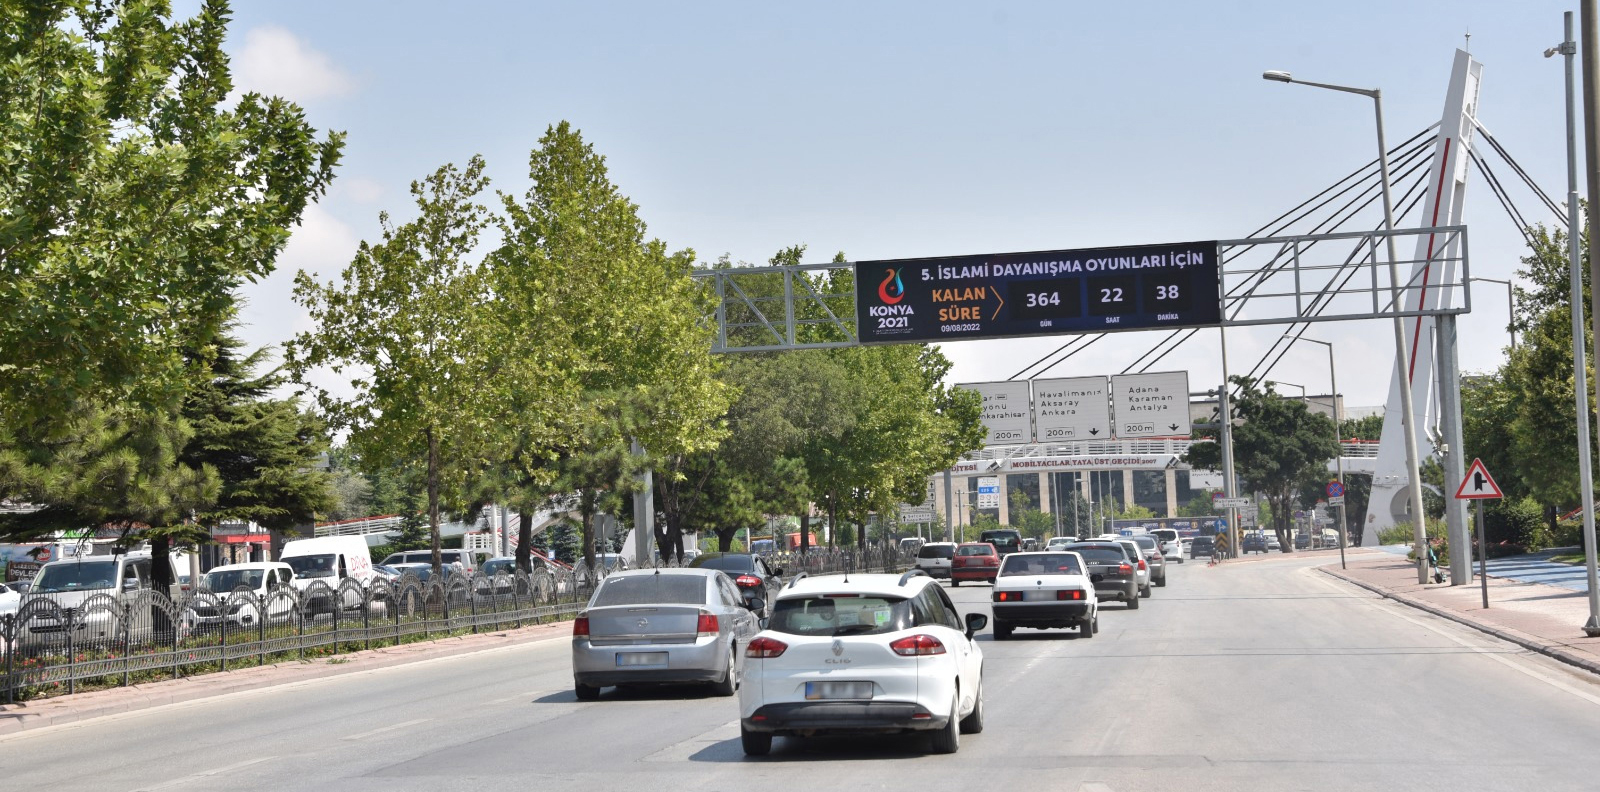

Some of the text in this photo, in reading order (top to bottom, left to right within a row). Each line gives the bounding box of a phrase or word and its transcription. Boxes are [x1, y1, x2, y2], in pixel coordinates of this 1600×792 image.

[921, 250, 1204, 281] 5. İSLAMİ DAYANIŞMA OYUNLARI İÇİN
[931, 286, 986, 303] KALAN
[1100, 287, 1123, 303] 22
[1156, 284, 1179, 300] 38
[1026, 291, 1060, 307] 364
[869, 304, 915, 317] KONYA
[938, 304, 981, 322] SÜRE
[1105, 316, 1121, 324] SAAT
[1157, 311, 1179, 321] DAKİKA
[877, 316, 909, 329] 2021
[1039, 319, 1053, 328] GÜN
[940, 323, 981, 333] 09/08/2022
[1039, 390, 1097, 399] Havalimanı
[1128, 386, 1160, 394] Adana
[1040, 400, 1080, 408] Aksaray
[1128, 395, 1173, 403] Karaman
[1041, 409, 1076, 417] Ankara
[1129, 404, 1168, 412] Antalya
[979, 411, 1026, 420] nkarahisar
[1012, 459, 1071, 469] MOBİLYACILAR
[1072, 459, 1092, 467] YAYA
[1094, 456, 1110, 465] ÜST
[1111, 455, 1140, 466] GEÇİDİ
